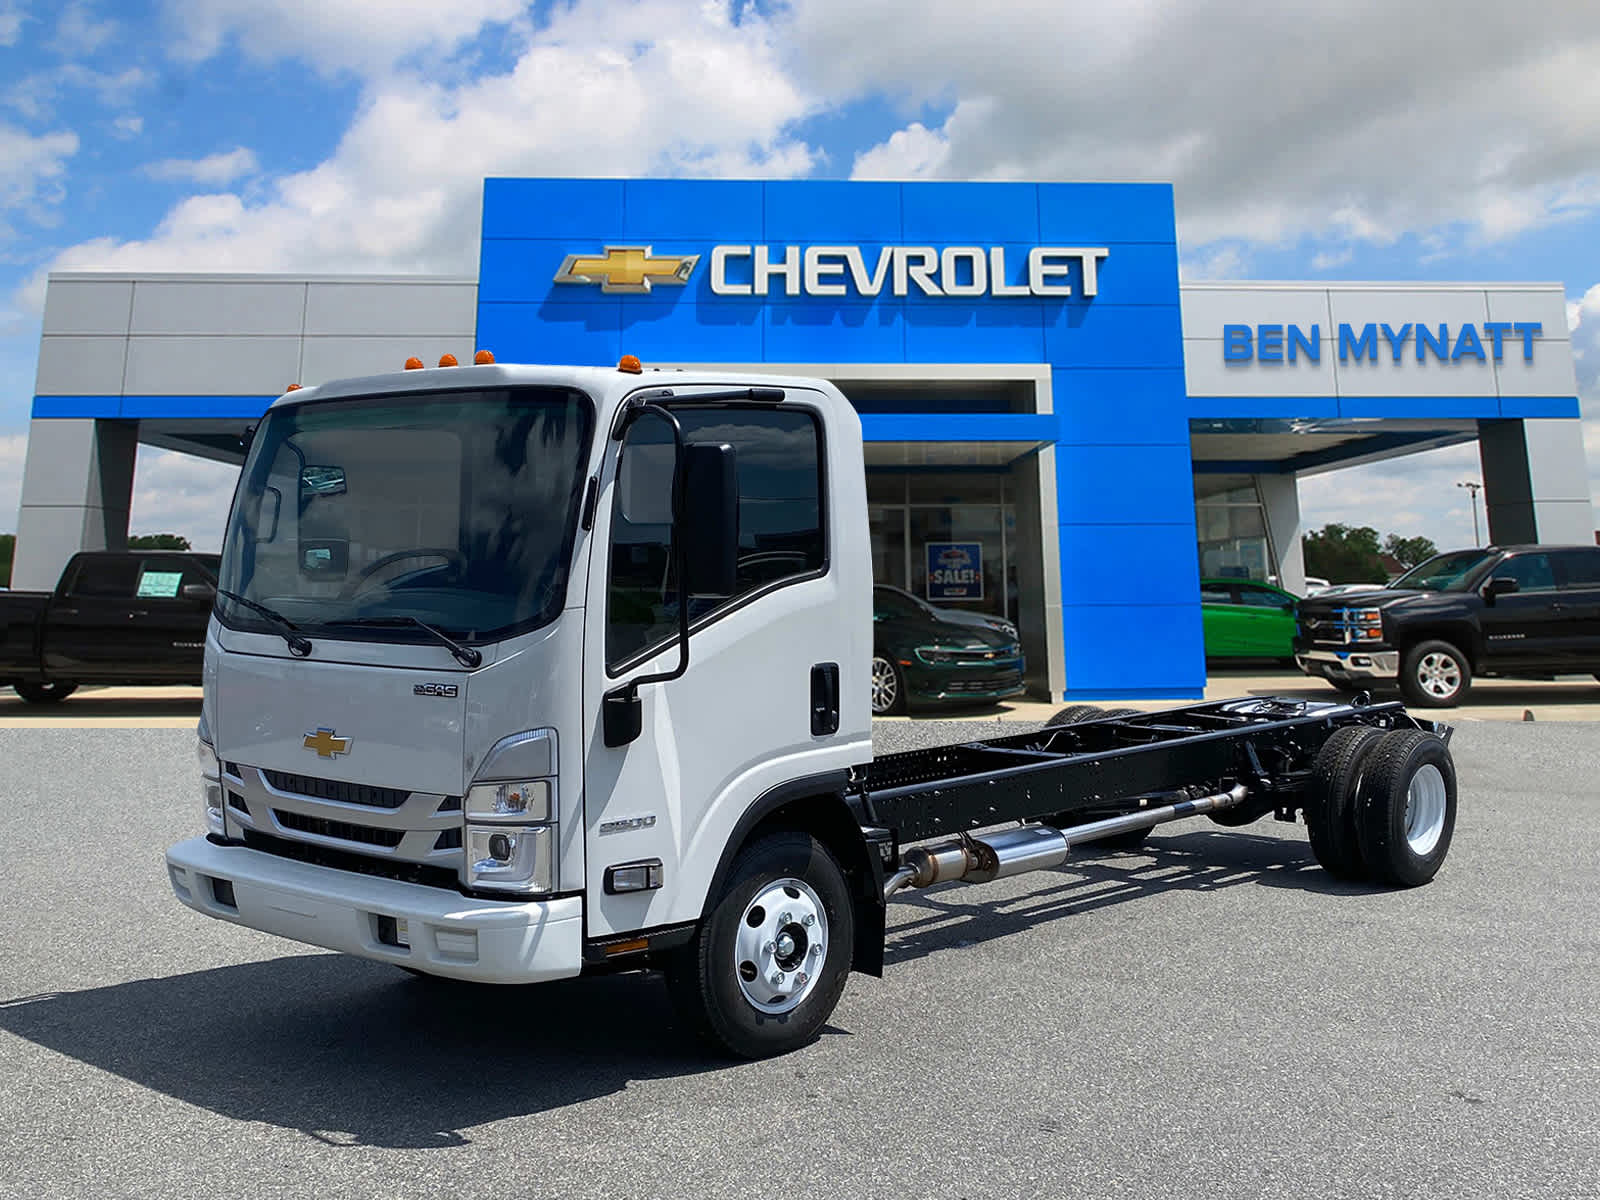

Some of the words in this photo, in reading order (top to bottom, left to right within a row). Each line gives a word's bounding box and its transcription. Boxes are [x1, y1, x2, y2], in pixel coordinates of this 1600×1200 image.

[711, 245, 1109, 297] CHEVROLET
[1223, 323, 1321, 362] BEN
[1338, 322, 1543, 362] MYNATT
[934, 569, 975, 585] SALE!
[424, 683, 457, 697] GAS
